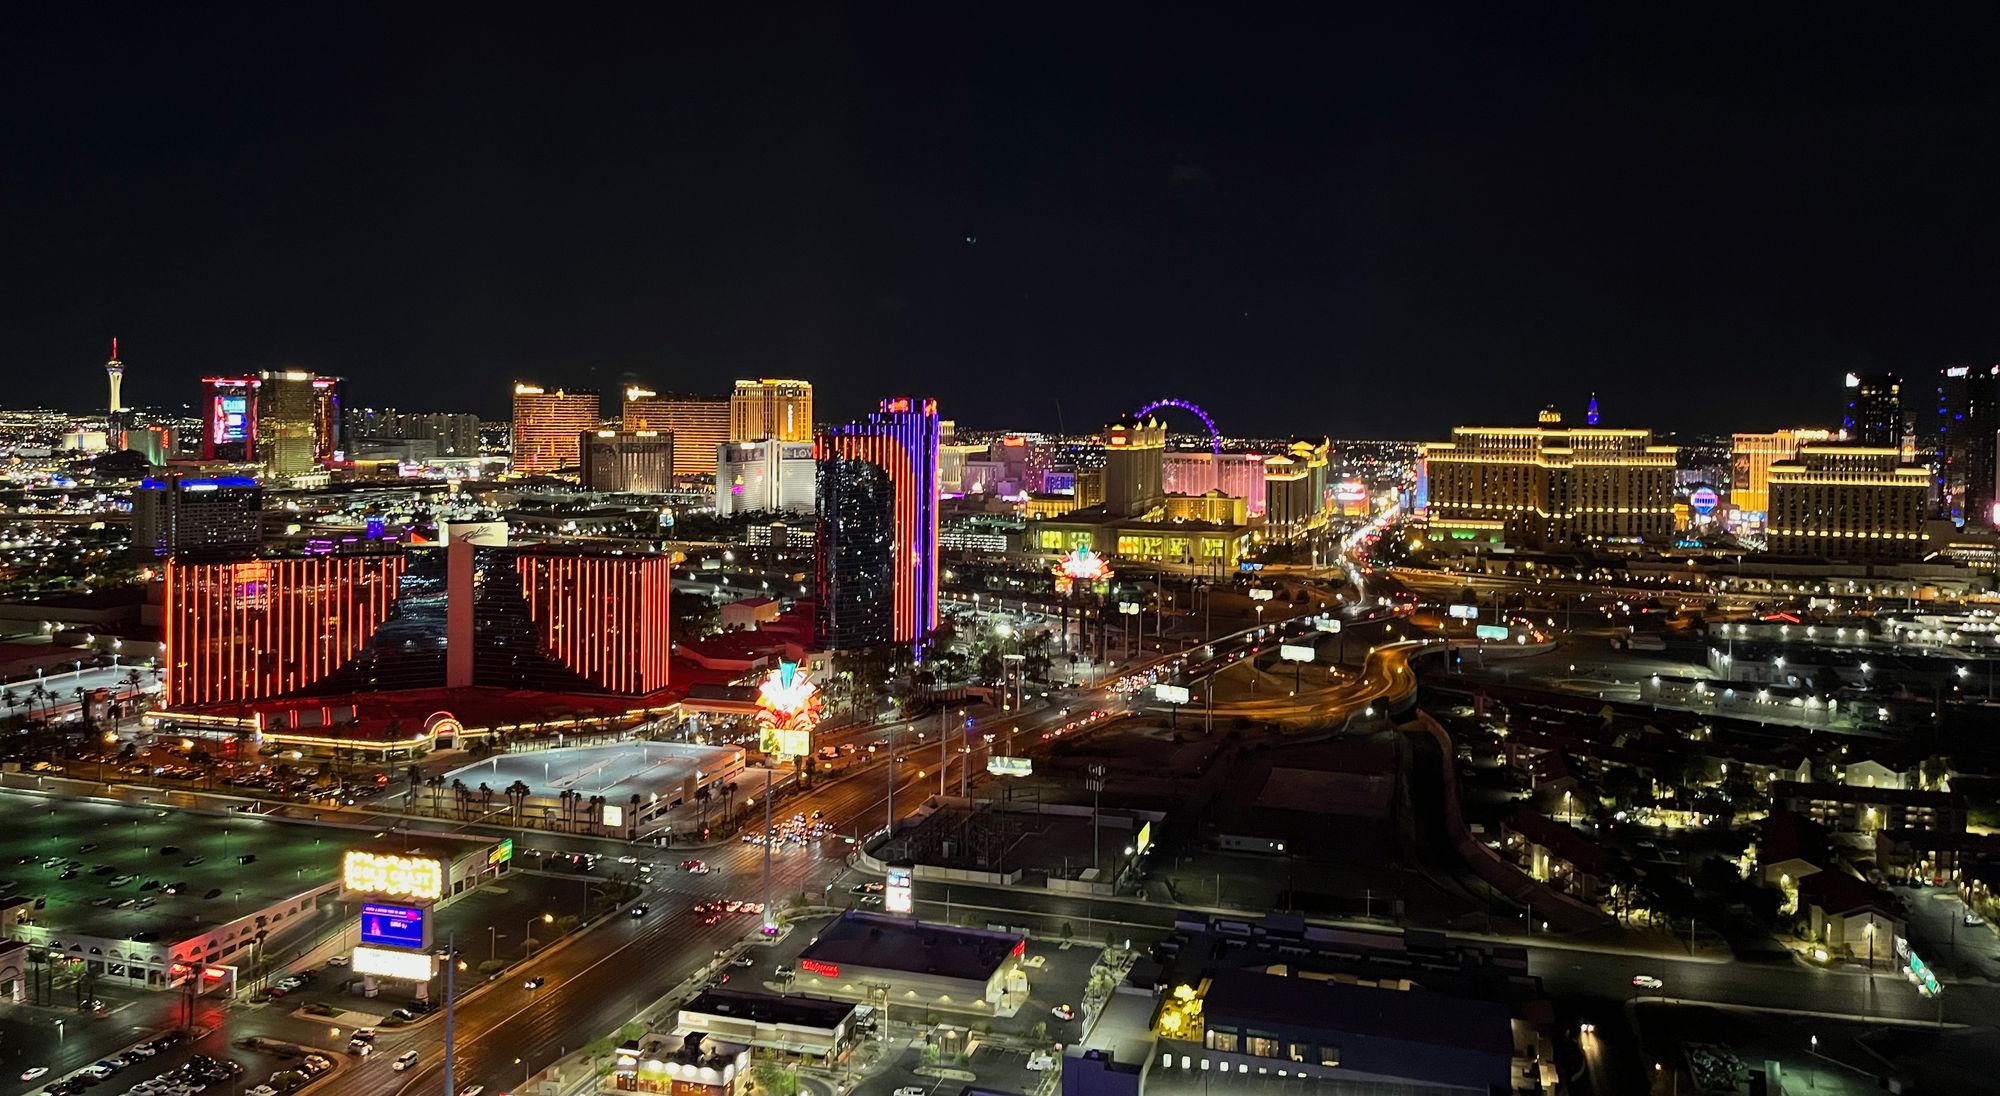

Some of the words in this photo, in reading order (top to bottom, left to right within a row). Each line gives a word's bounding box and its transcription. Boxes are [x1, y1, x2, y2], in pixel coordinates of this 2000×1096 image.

[354, 865, 386, 882] GOLD
[389, 869, 431, 886] COAST
[802, 960, 838, 973] Walgreens
